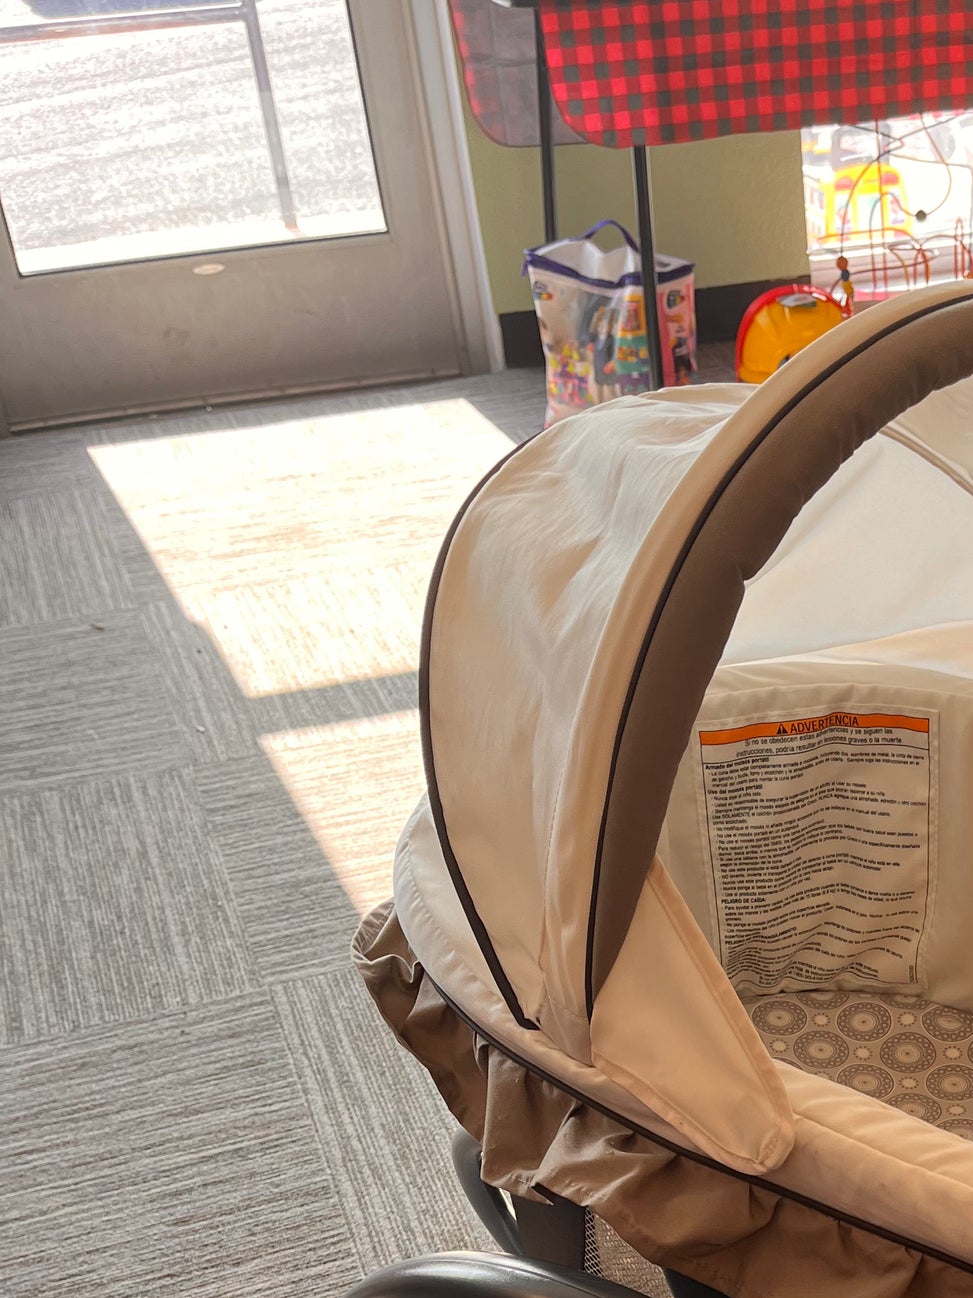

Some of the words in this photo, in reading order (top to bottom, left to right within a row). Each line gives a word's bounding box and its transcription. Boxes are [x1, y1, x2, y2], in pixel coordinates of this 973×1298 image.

[790, 715, 859, 733] ADVERTENCIA
[769, 736, 798, 744] obedecen
[816, 728, 848, 738] advertencias
[796, 741, 816, 751] resultar
